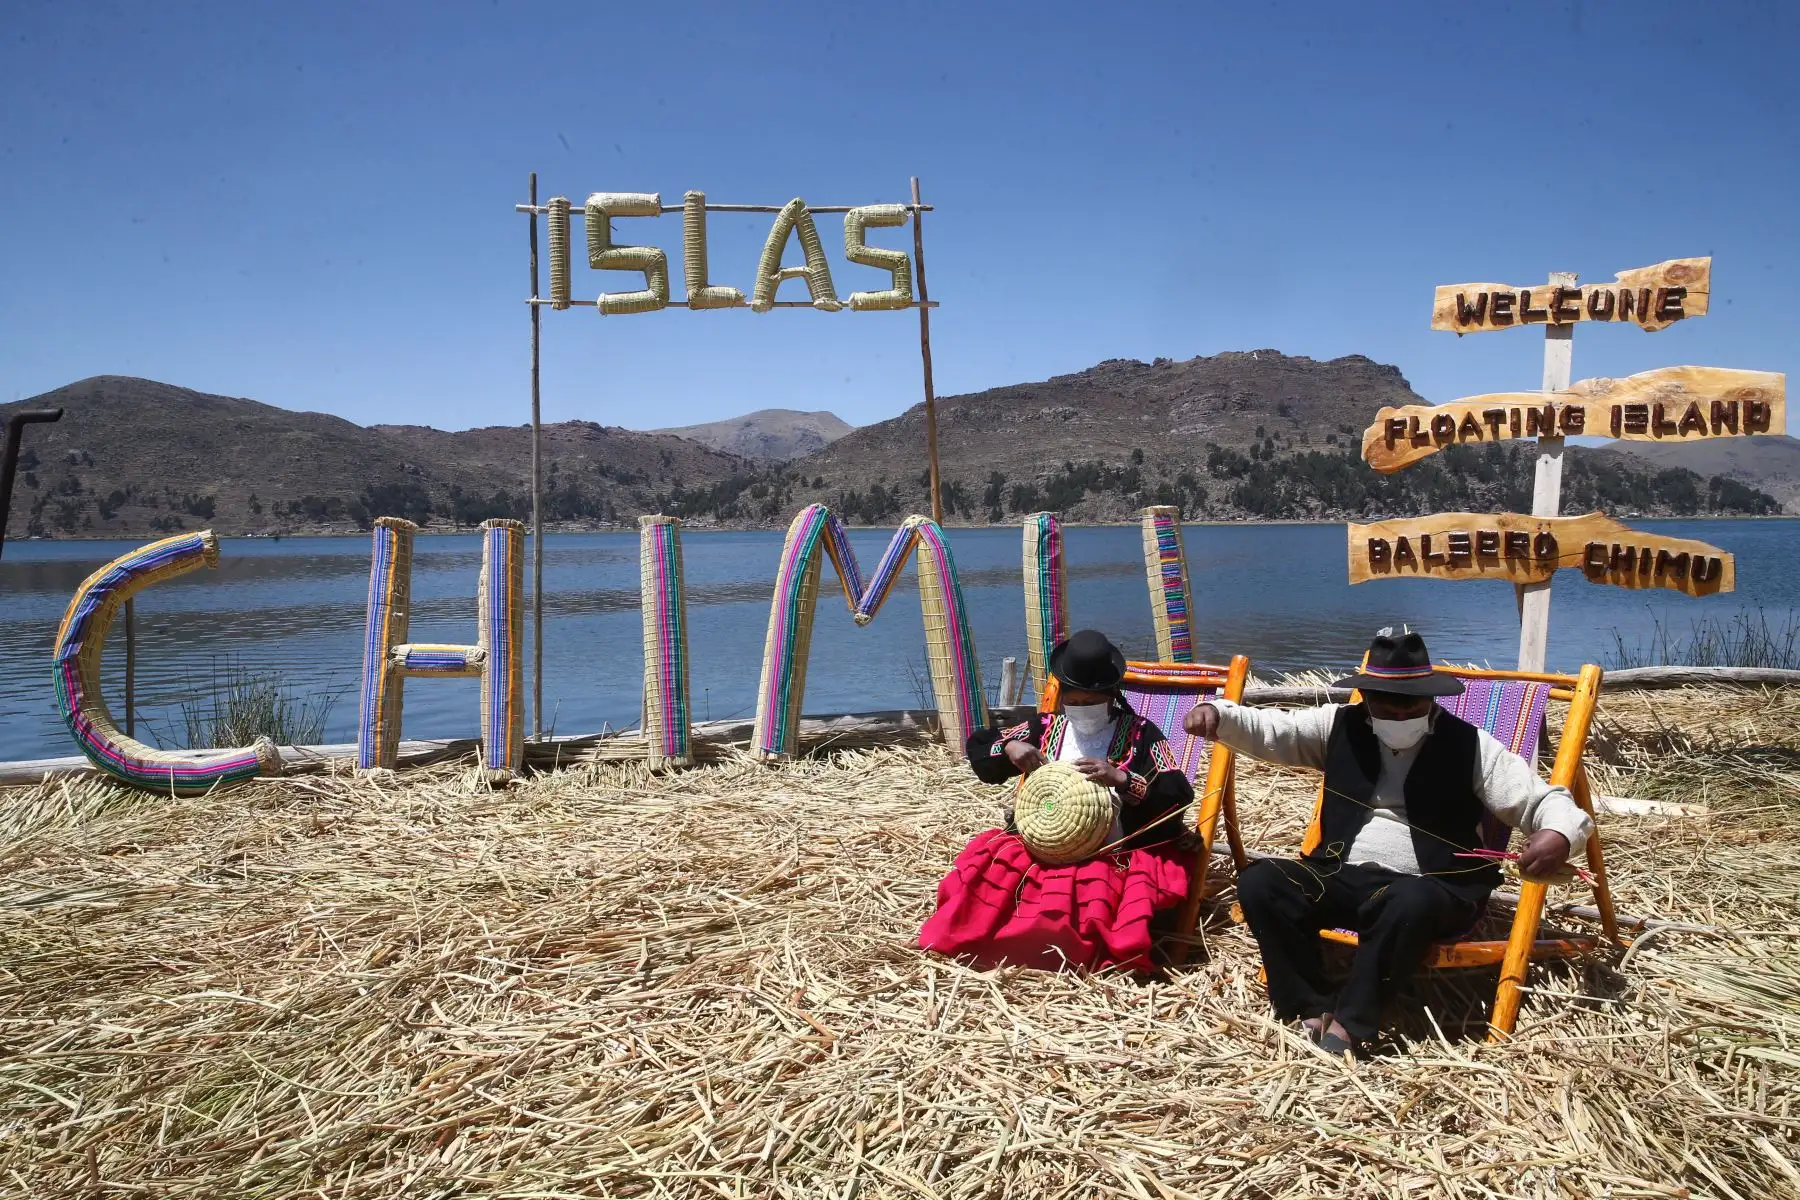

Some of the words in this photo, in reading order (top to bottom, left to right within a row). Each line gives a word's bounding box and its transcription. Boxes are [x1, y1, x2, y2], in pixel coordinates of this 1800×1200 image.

[548, 190, 912, 315] ISLAS
[1384, 404, 1586, 441] FLOATING
[1610, 400, 1771, 438] ISLAND
[1367, 530, 1560, 565] BALSERO
[1584, 541, 1722, 582] CHIMU
